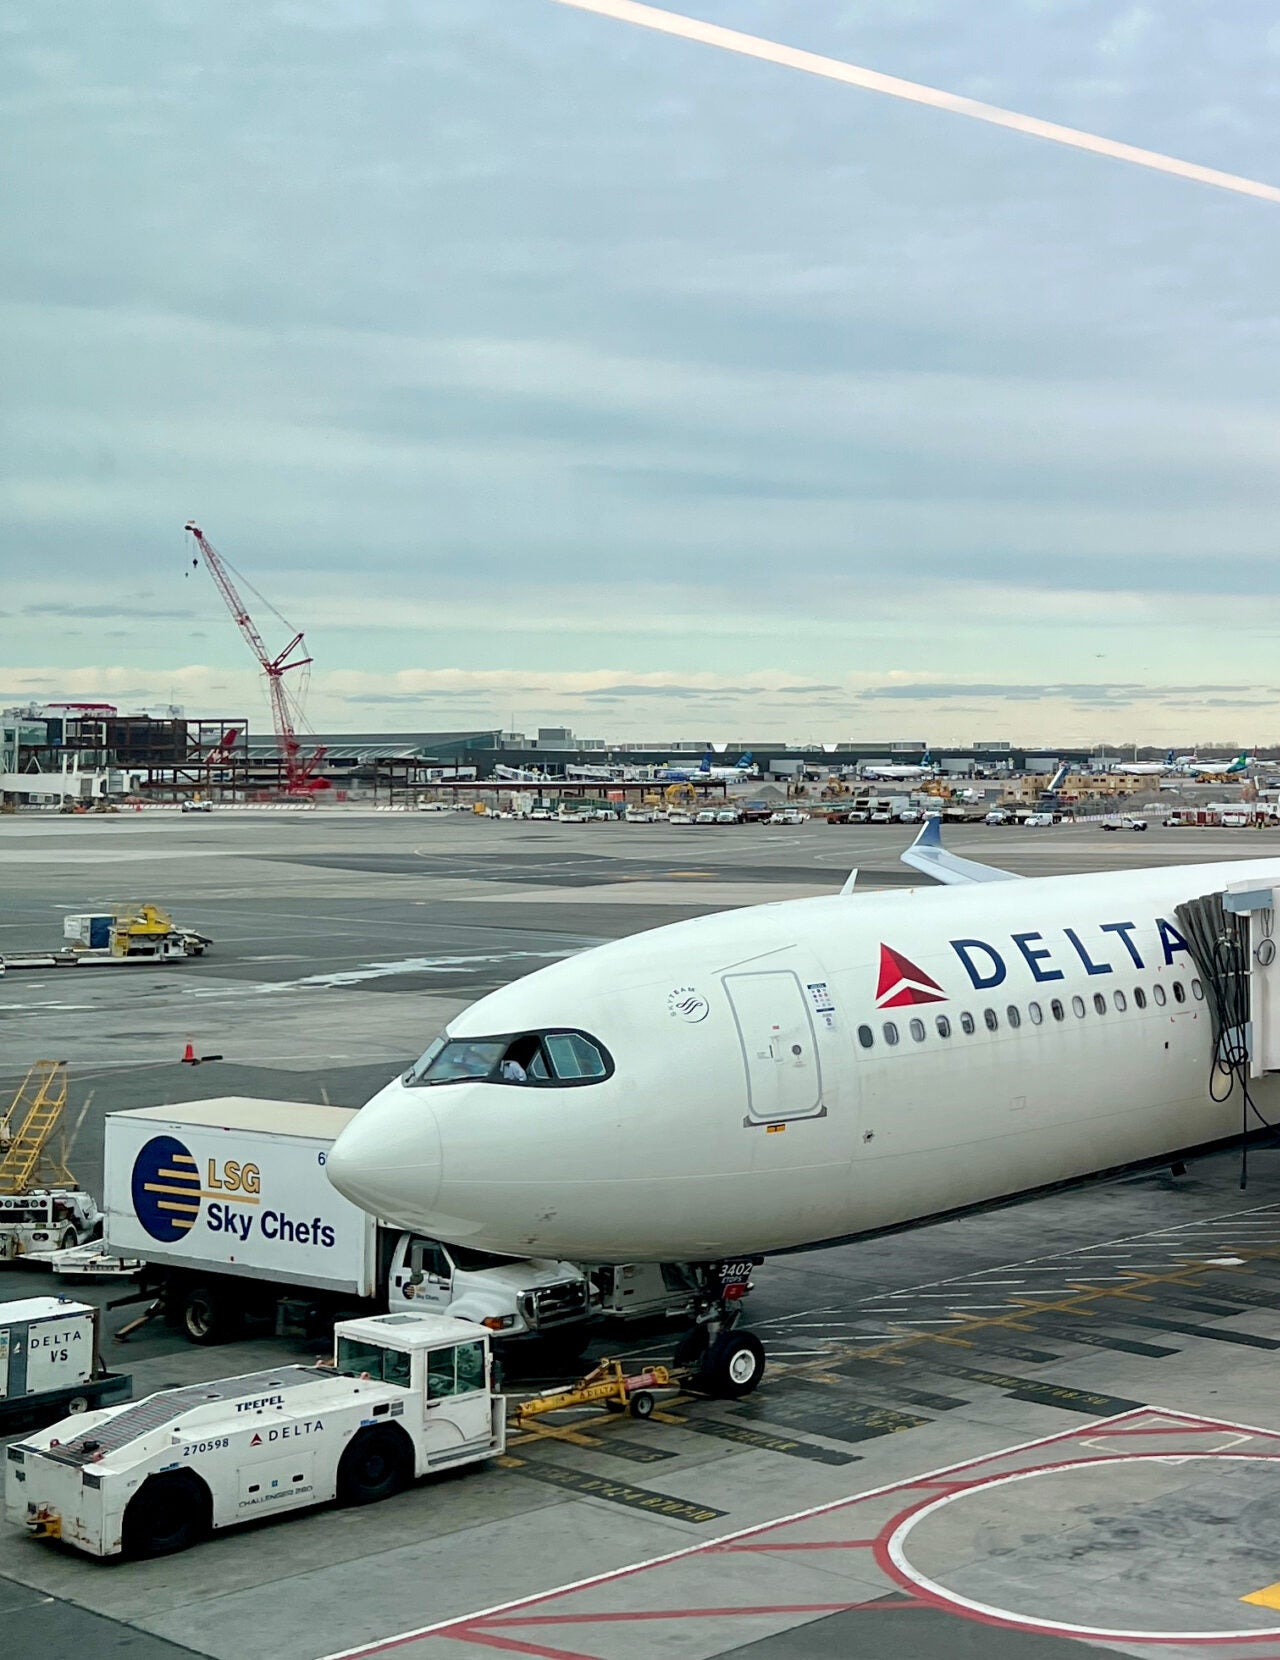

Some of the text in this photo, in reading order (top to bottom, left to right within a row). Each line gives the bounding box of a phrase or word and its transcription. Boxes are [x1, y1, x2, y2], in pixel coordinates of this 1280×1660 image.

[949, 917, 1191, 990] DELTA
[207, 1158, 261, 1194] LSG
[206, 1203, 336, 1247] Sky Chefs
[718, 1262, 753, 1277] 3402
[30, 1330, 82, 1349] DELTA
[50, 1349, 69, 1363] VS
[235, 1395, 285, 1412] TREPEL
[268, 1420, 324, 1442] DELTA
[183, 1438, 230, 1457] 270598
[238, 1489, 294, 1508] CHALLENGER
